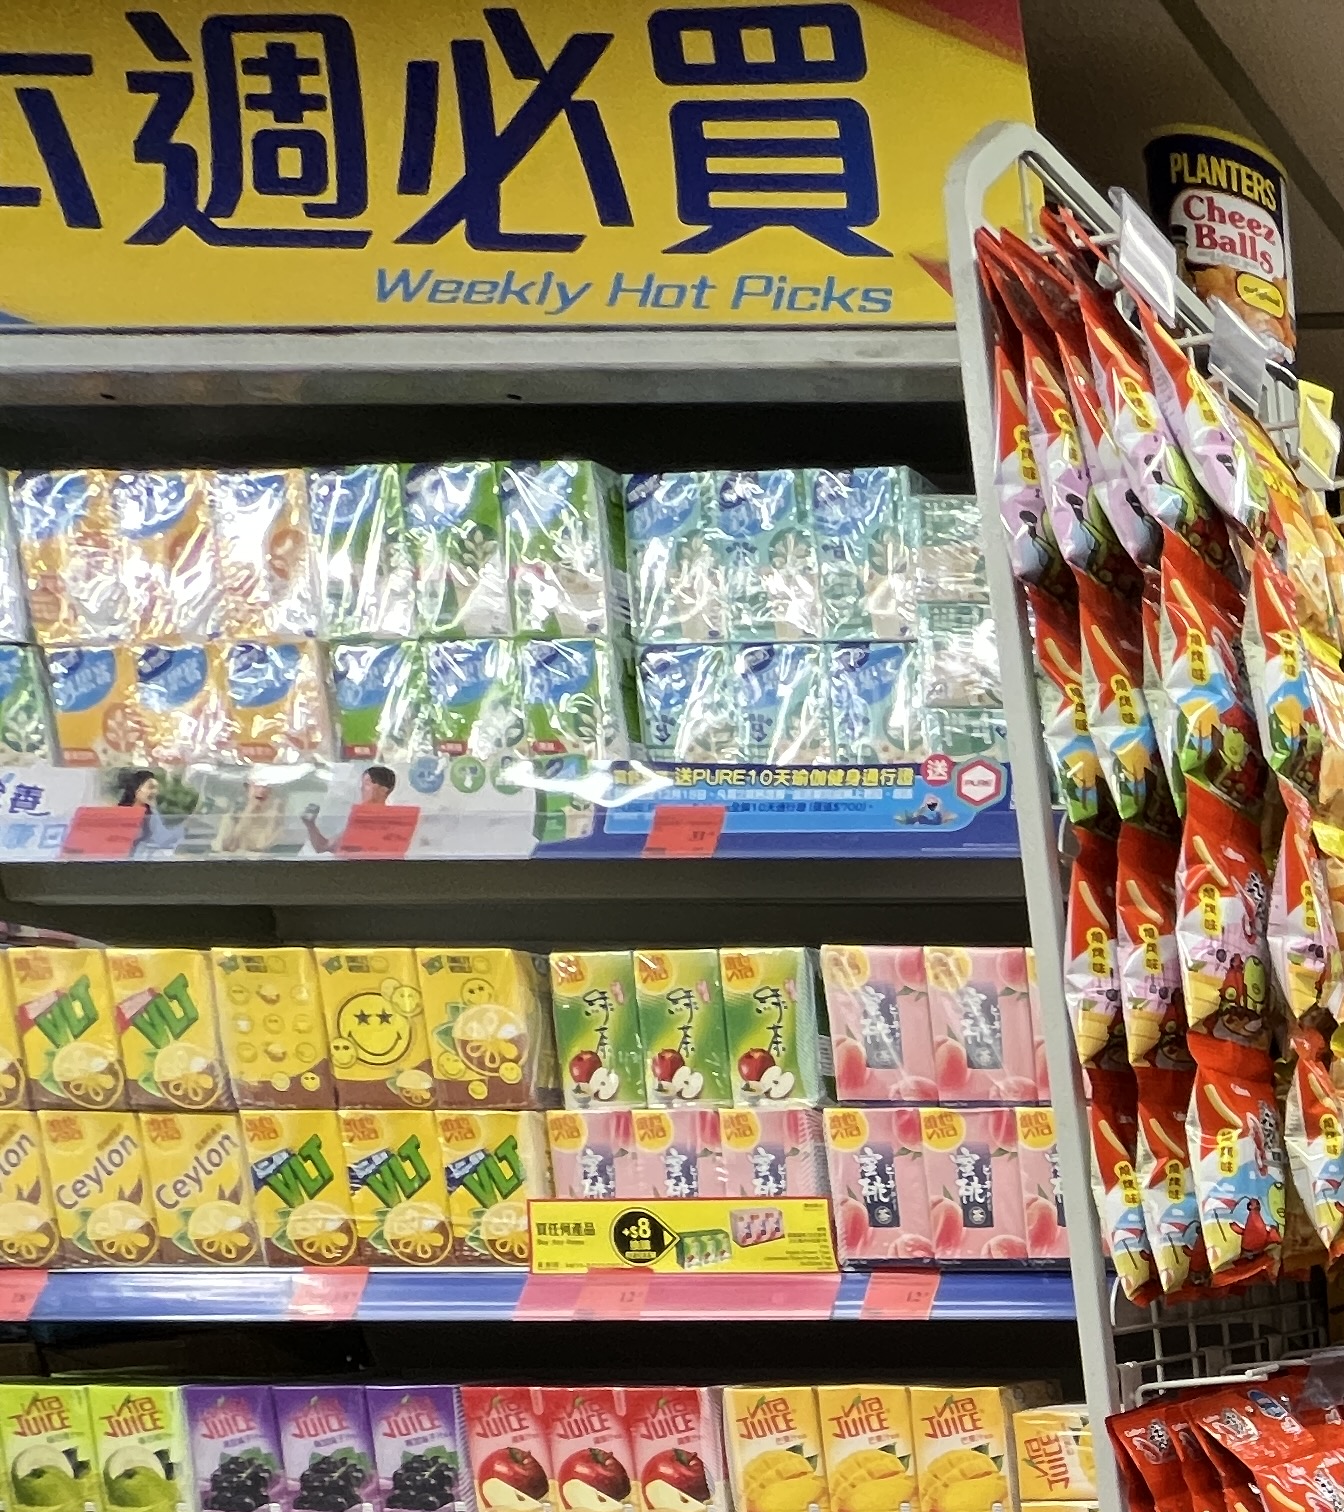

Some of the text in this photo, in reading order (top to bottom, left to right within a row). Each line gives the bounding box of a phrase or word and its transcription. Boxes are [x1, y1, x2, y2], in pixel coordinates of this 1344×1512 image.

[1169, 151, 1278, 212] PLANTERS
[1182, 193, 1277, 246] Cheez
[1194, 223, 1274, 275] Balls
[375, 268, 894, 316] Weekly Hot Picks
[927, 759, 950, 780] 送
[55, 1131, 141, 1211] Ceylon
[155, 1130, 241, 1211] Ceylon
[264, 1133, 336, 1210] VLT
[362, 1132, 434, 1208] VLT
[461, 1132, 526, 1208] VLT
[9, 1411, 71, 1438] JUICE
[101, 1411, 165, 1438] JUICE
[736, 1411, 798, 1439] JUICE
[828, 1411, 890, 1439] JUICE
[921, 1411, 984, 1439] JUICE
